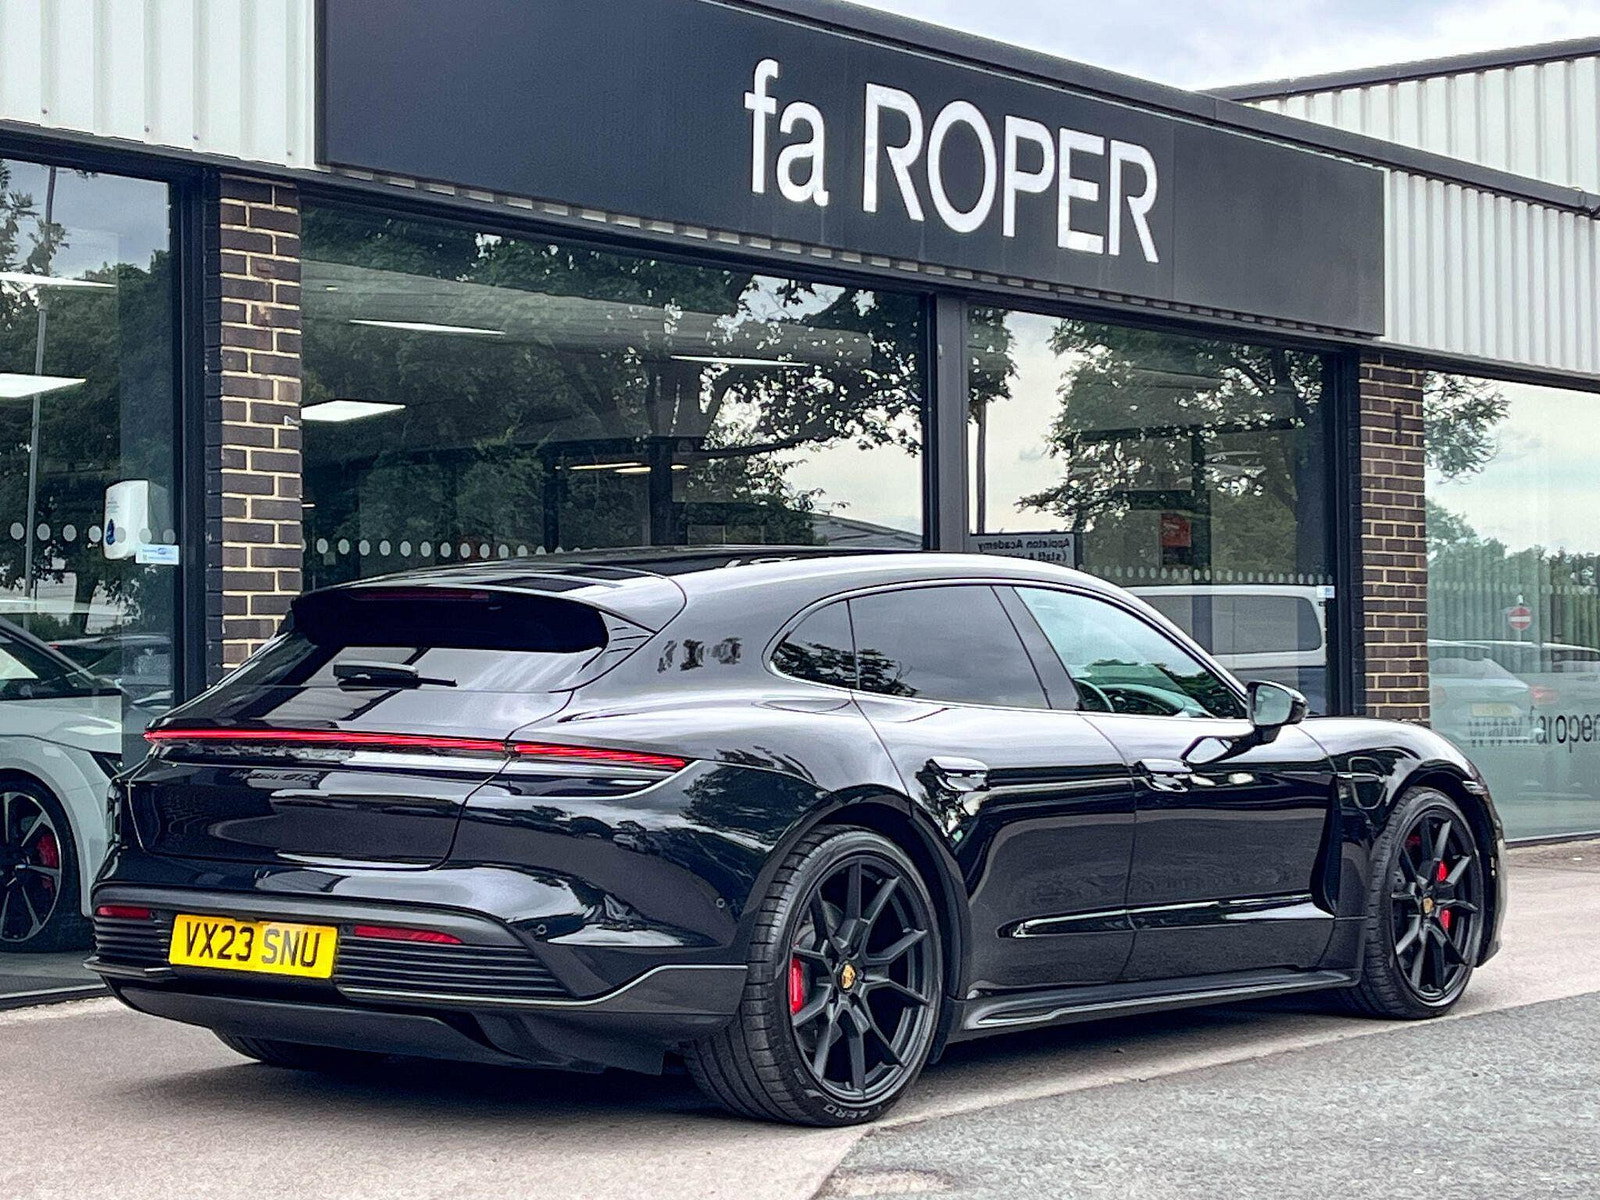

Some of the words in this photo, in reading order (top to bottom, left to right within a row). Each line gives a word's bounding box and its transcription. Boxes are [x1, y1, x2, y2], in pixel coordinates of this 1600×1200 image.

[744, 58, 829, 207] fa
[863, 82, 1159, 264] ROPER
[185, 920, 255, 962] VX23
[261, 928, 321, 968] SNU
